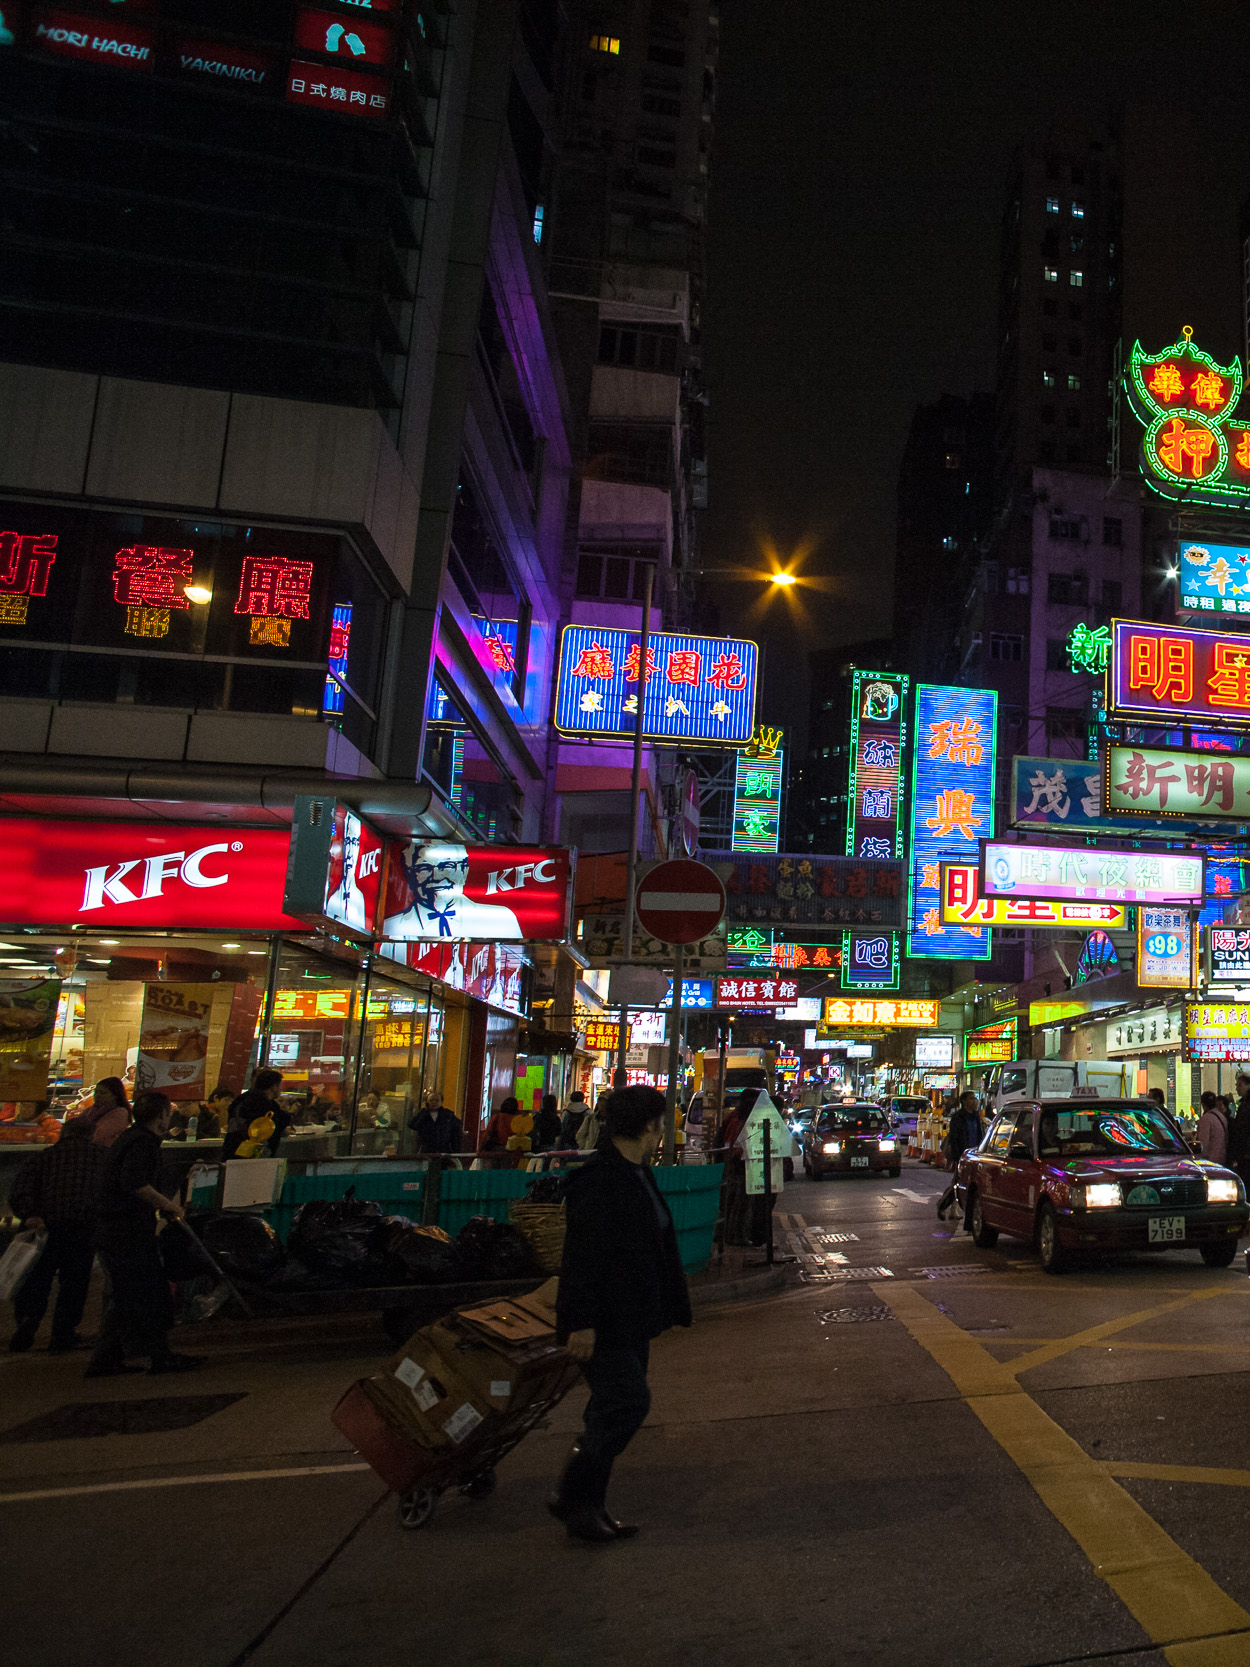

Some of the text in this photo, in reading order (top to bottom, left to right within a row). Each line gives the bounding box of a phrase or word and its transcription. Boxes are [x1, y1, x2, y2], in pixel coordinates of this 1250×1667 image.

[36, 23, 150, 60] MORI HACHI
[180, 55, 265, 83] YAKINIKU
[291, 79, 387, 109] 日式燒肉店
[1158, 417, 1216, 478] 押
[1184, 595, 1215, 611] 時租
[1067, 622, 1113, 668] 新
[79, 841, 229, 912] KFC
[359, 847, 381, 881] KFC
[486, 857, 557, 897] KFC
[1020, 851, 1200, 891] 時代夜總會
[1148, 935, 1178, 955] $98
[1213, 951, 1250, 961] SUN
[719, 980, 798, 999] 誠信賓館
[829, 1001, 896, 1023] 金如意
[1075, 1086, 1097, 1095] TAXI
[1151, 1228, 1184, 1240] 7199
[1157, 1217, 1175, 1229] EV
